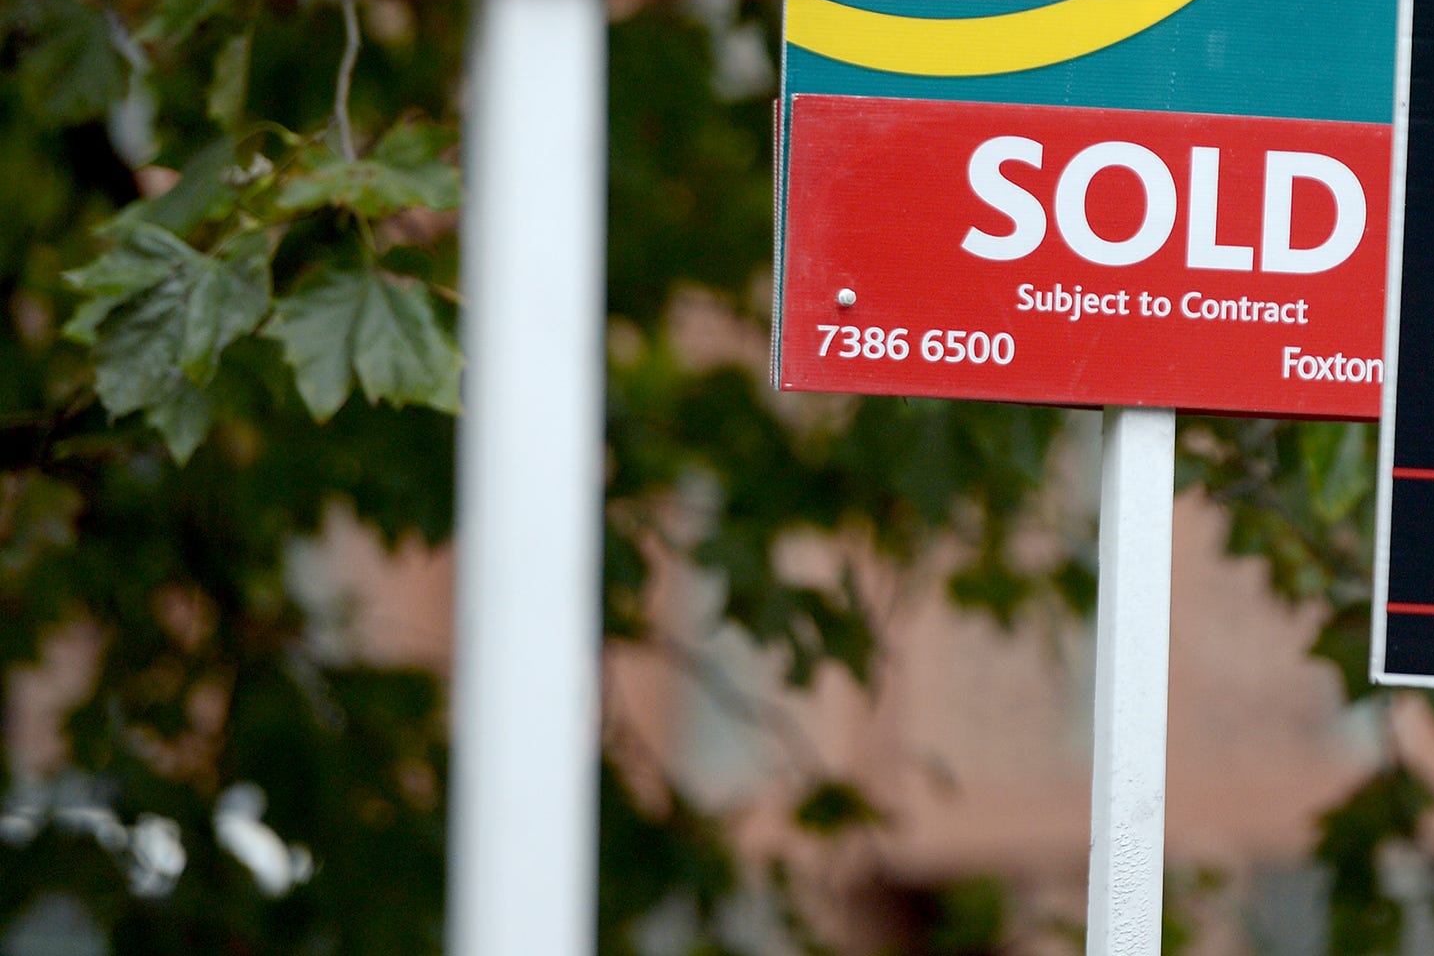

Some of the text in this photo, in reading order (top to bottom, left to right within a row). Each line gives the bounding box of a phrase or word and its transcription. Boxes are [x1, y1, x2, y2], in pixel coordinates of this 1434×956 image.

[960, 134, 1367, 275] SOLD
[1017, 284, 1309, 325] Subject to Contract
[817, 325, 1016, 366] 7386 6500
